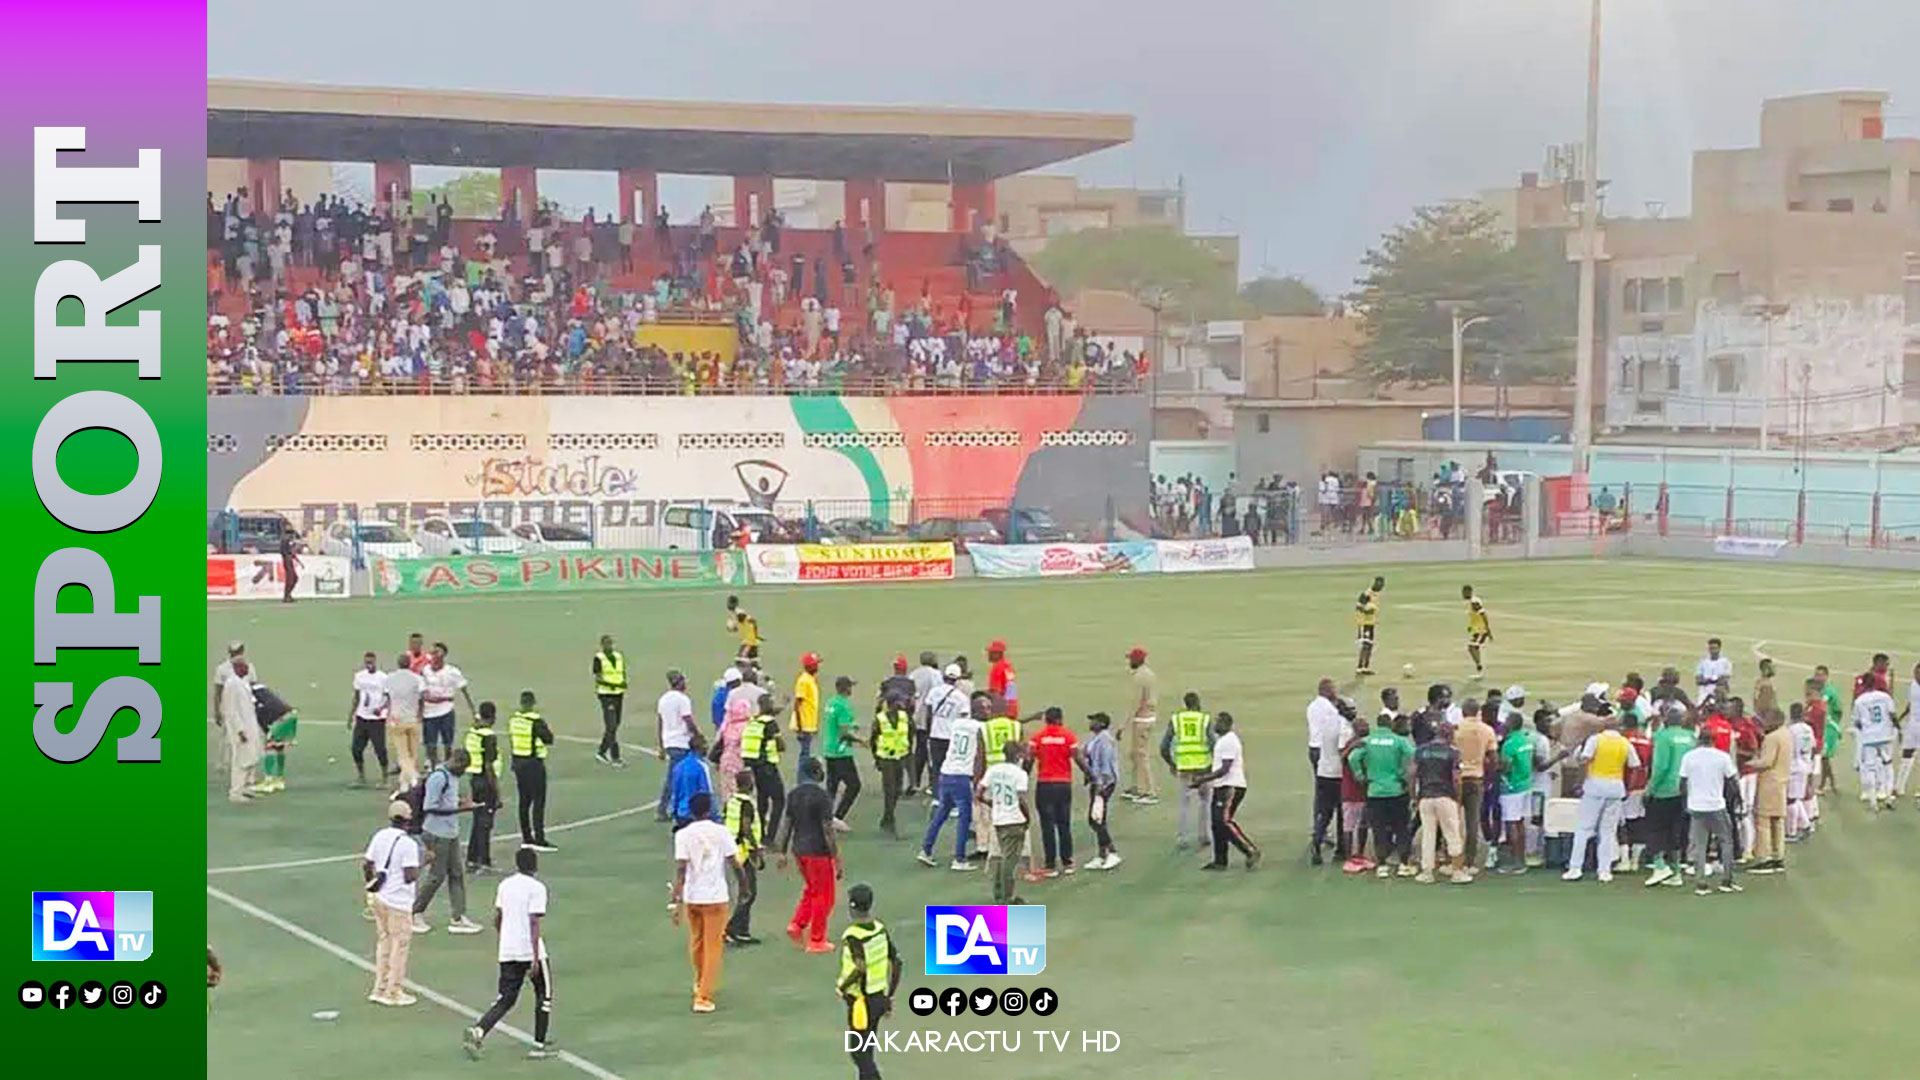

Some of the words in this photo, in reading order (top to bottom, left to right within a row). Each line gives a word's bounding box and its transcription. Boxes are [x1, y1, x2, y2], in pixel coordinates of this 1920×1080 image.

[482, 456, 626, 497] Stade
[423, 561, 500, 590] AS
[519, 555, 701, 584] PIKINE
